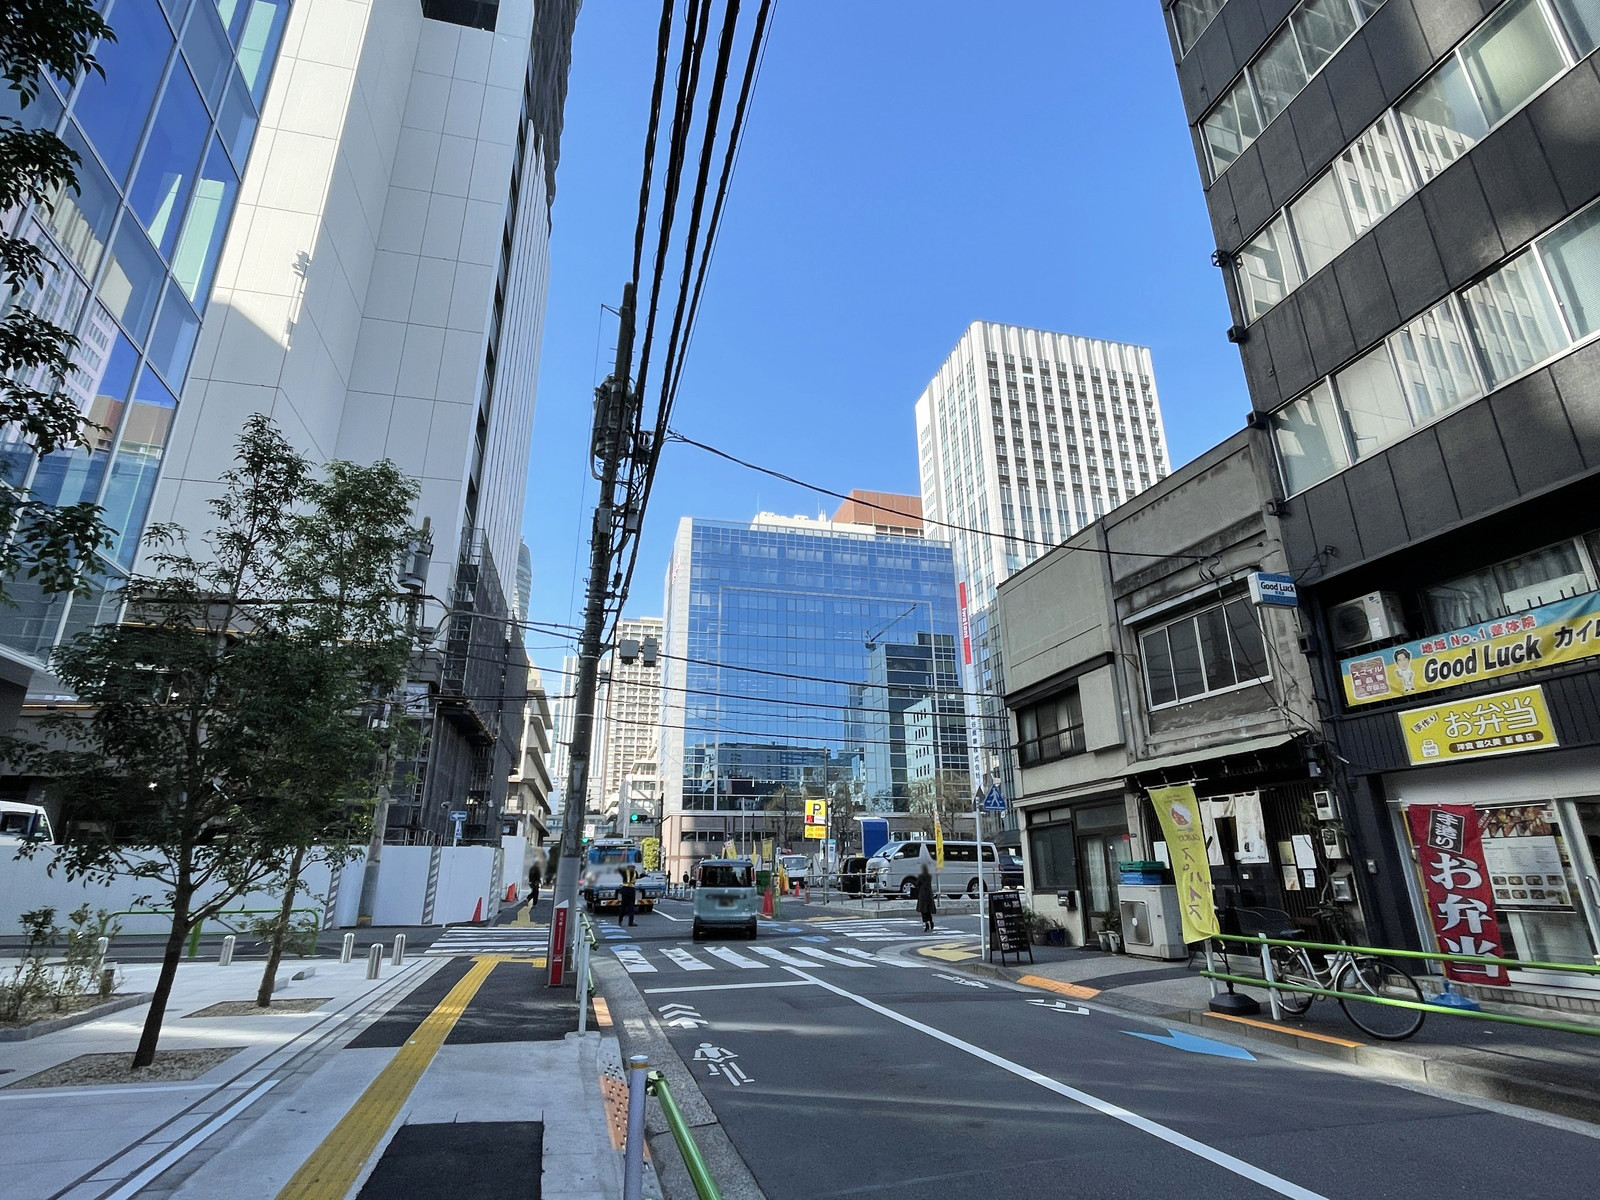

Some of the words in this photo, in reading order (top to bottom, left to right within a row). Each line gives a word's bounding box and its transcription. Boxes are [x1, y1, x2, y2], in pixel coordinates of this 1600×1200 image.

[1261, 581, 1278, 590] Good
[1280, 583, 1295, 592] Luck
[961, 607, 969, 639] Iwatani
[1450, 628, 1486, 647] No.1
[1424, 648, 1478, 683] Good
[1483, 634, 1542, 671] Luck
[1413, 714, 1437, 732] 手作り
[1443, 696, 1538, 738] お弁当
[813, 803, 821, 814] P
[1430, 852, 1500, 978] お弁当
